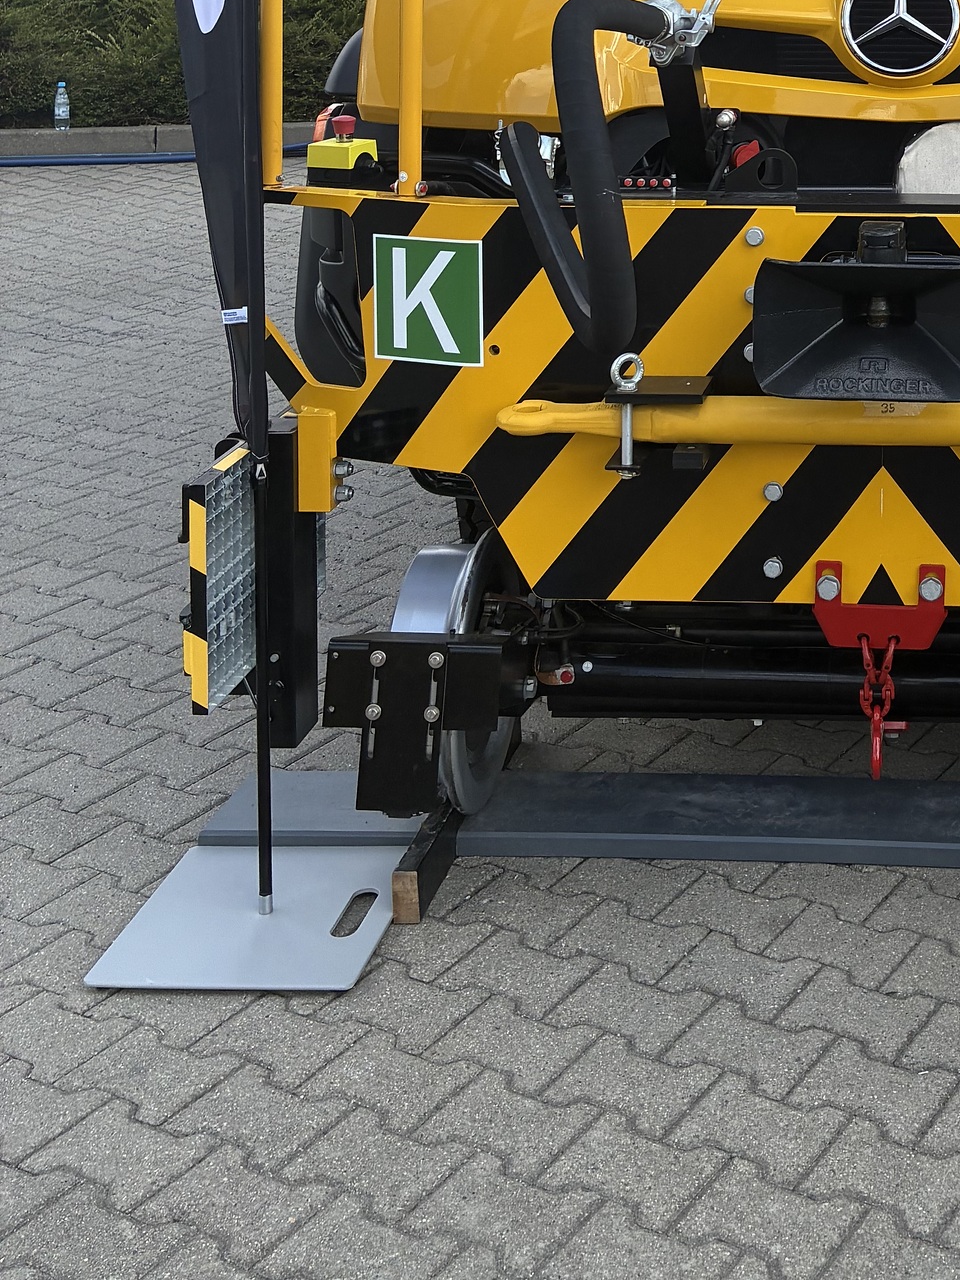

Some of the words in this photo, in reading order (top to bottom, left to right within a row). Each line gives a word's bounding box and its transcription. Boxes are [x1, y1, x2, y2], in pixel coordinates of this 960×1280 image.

[391, 246, 461, 354] K
[815, 376, 932, 393] ROCKINGER
[881, 402, 895, 413] 35
